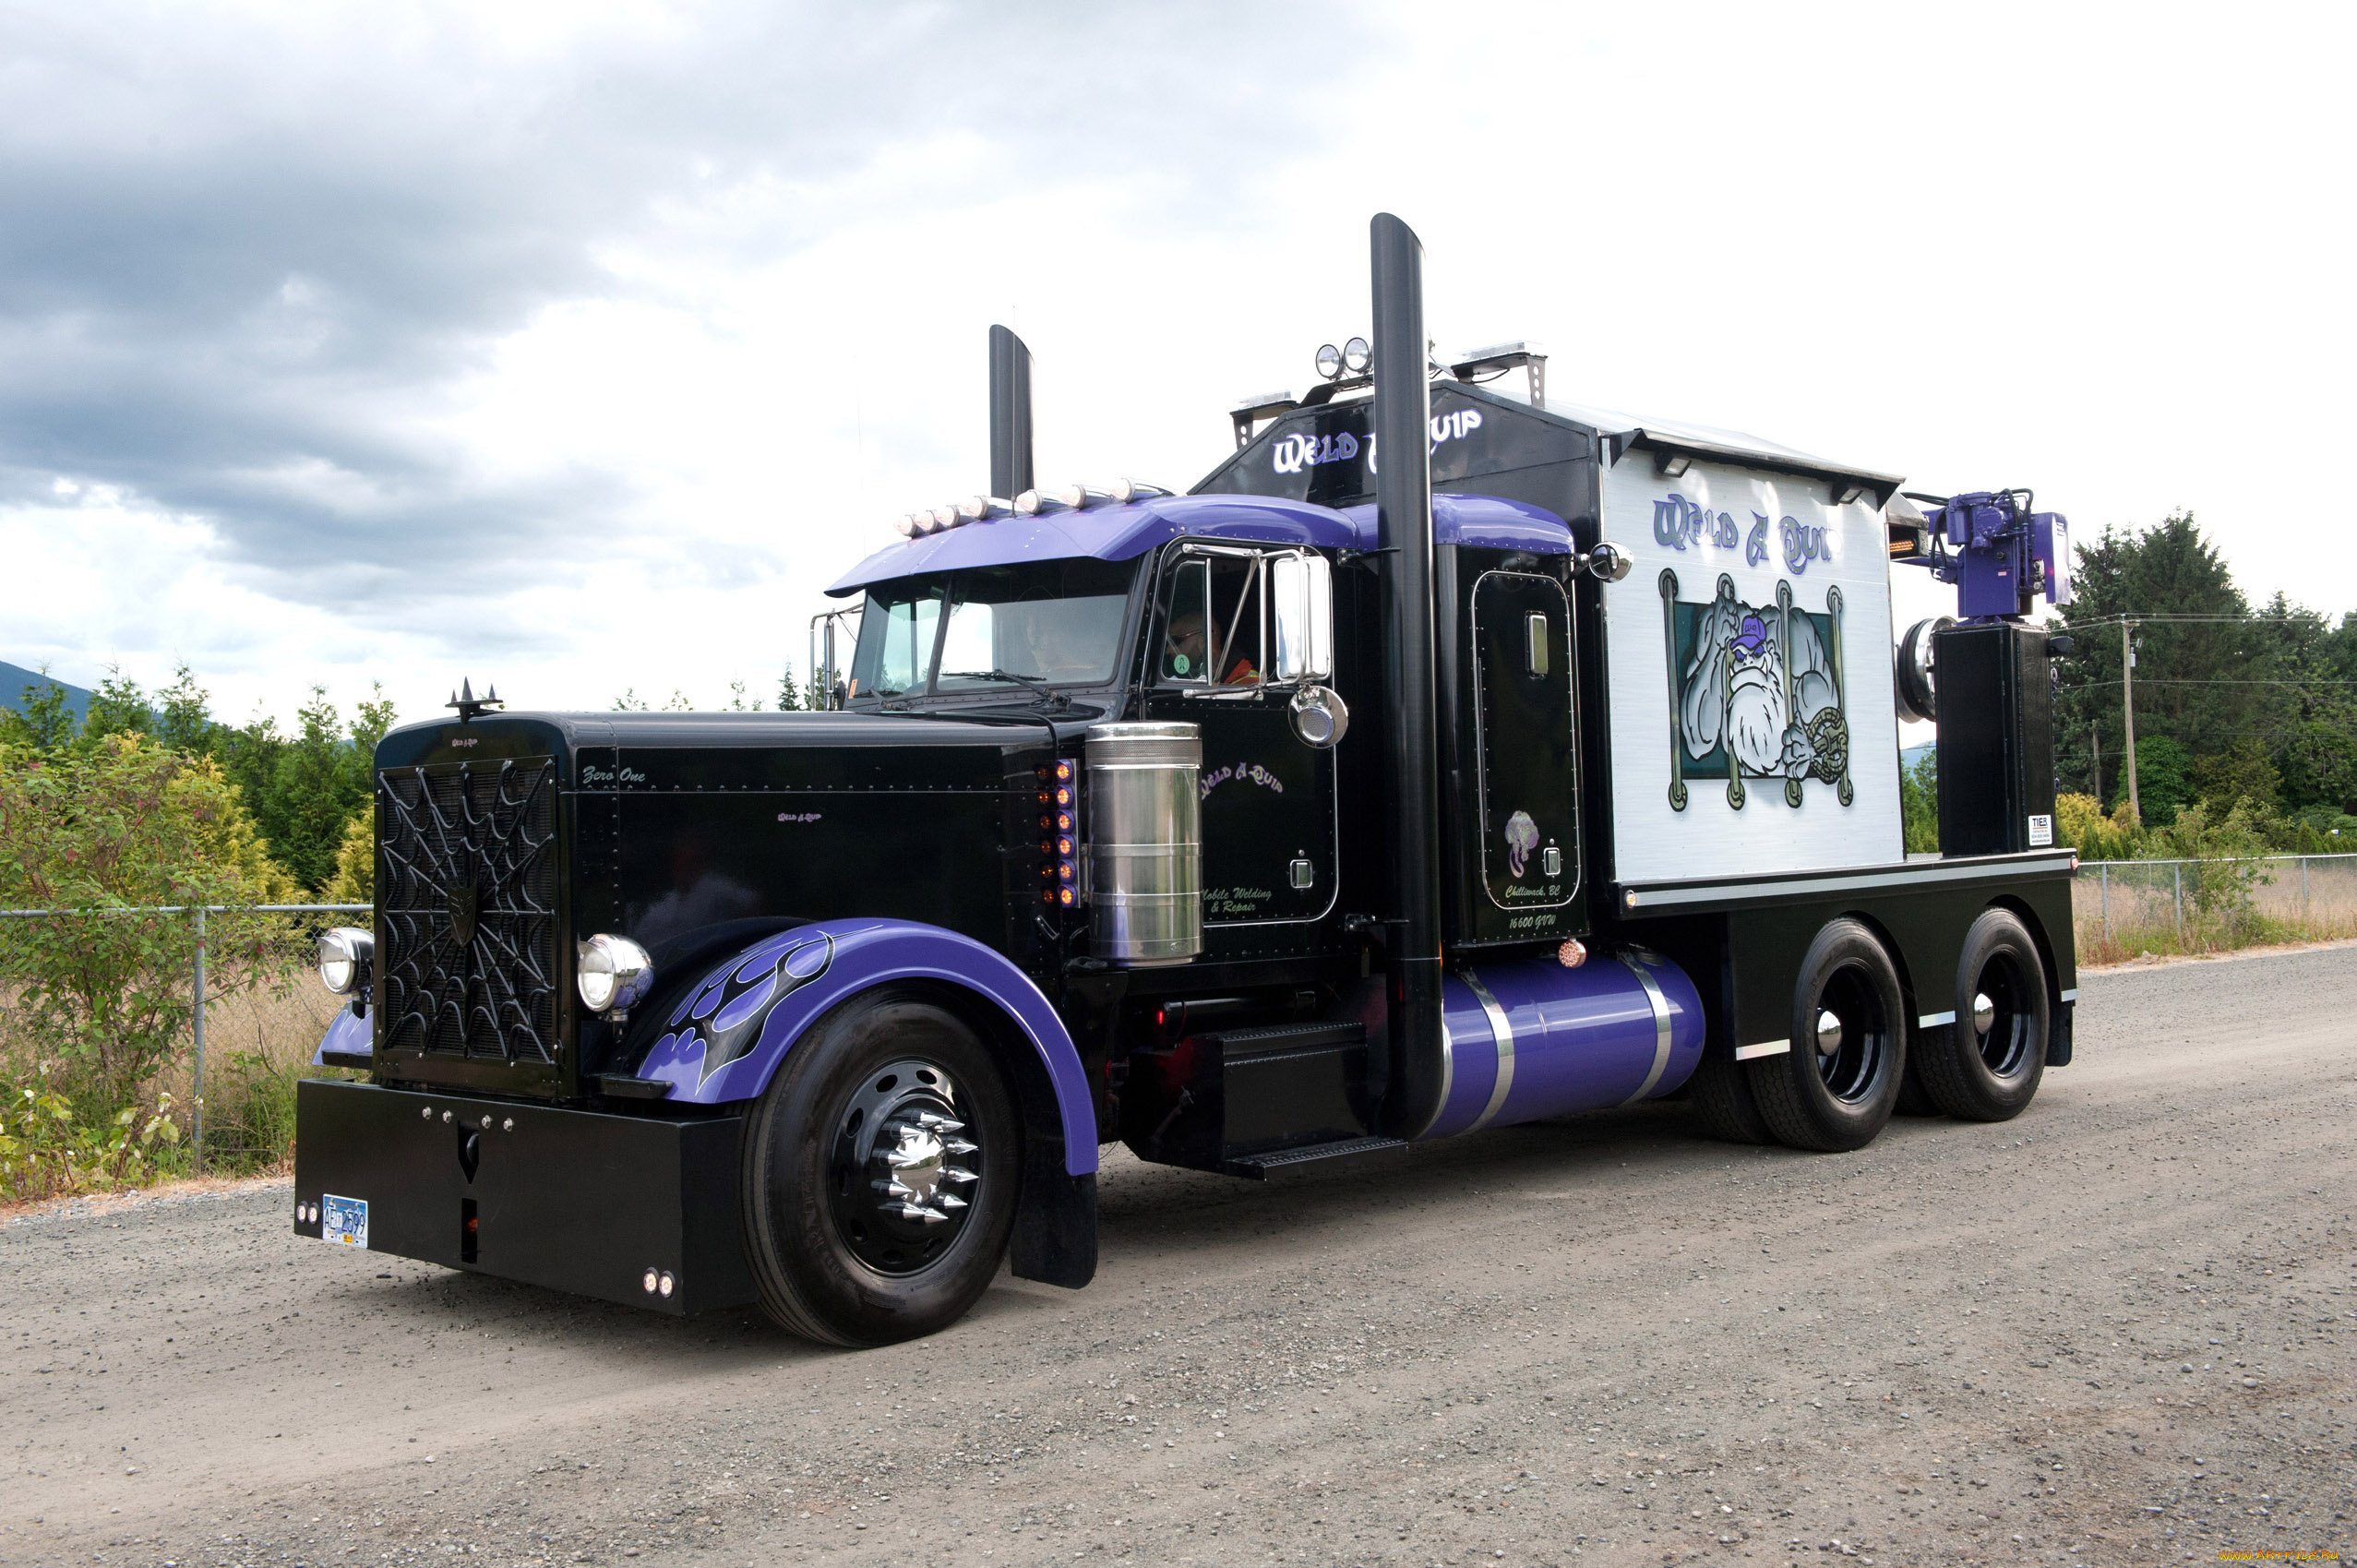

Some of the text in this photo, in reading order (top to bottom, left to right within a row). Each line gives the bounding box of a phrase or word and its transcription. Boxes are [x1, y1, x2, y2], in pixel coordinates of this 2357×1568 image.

[1430, 408, 1482, 456] UIP
[582, 765, 646, 784] Zero One
[1233, 887, 1273, 902] Welding
[1549, 884, 1561, 896] BC
[1211, 902, 1256, 914] & Repair
